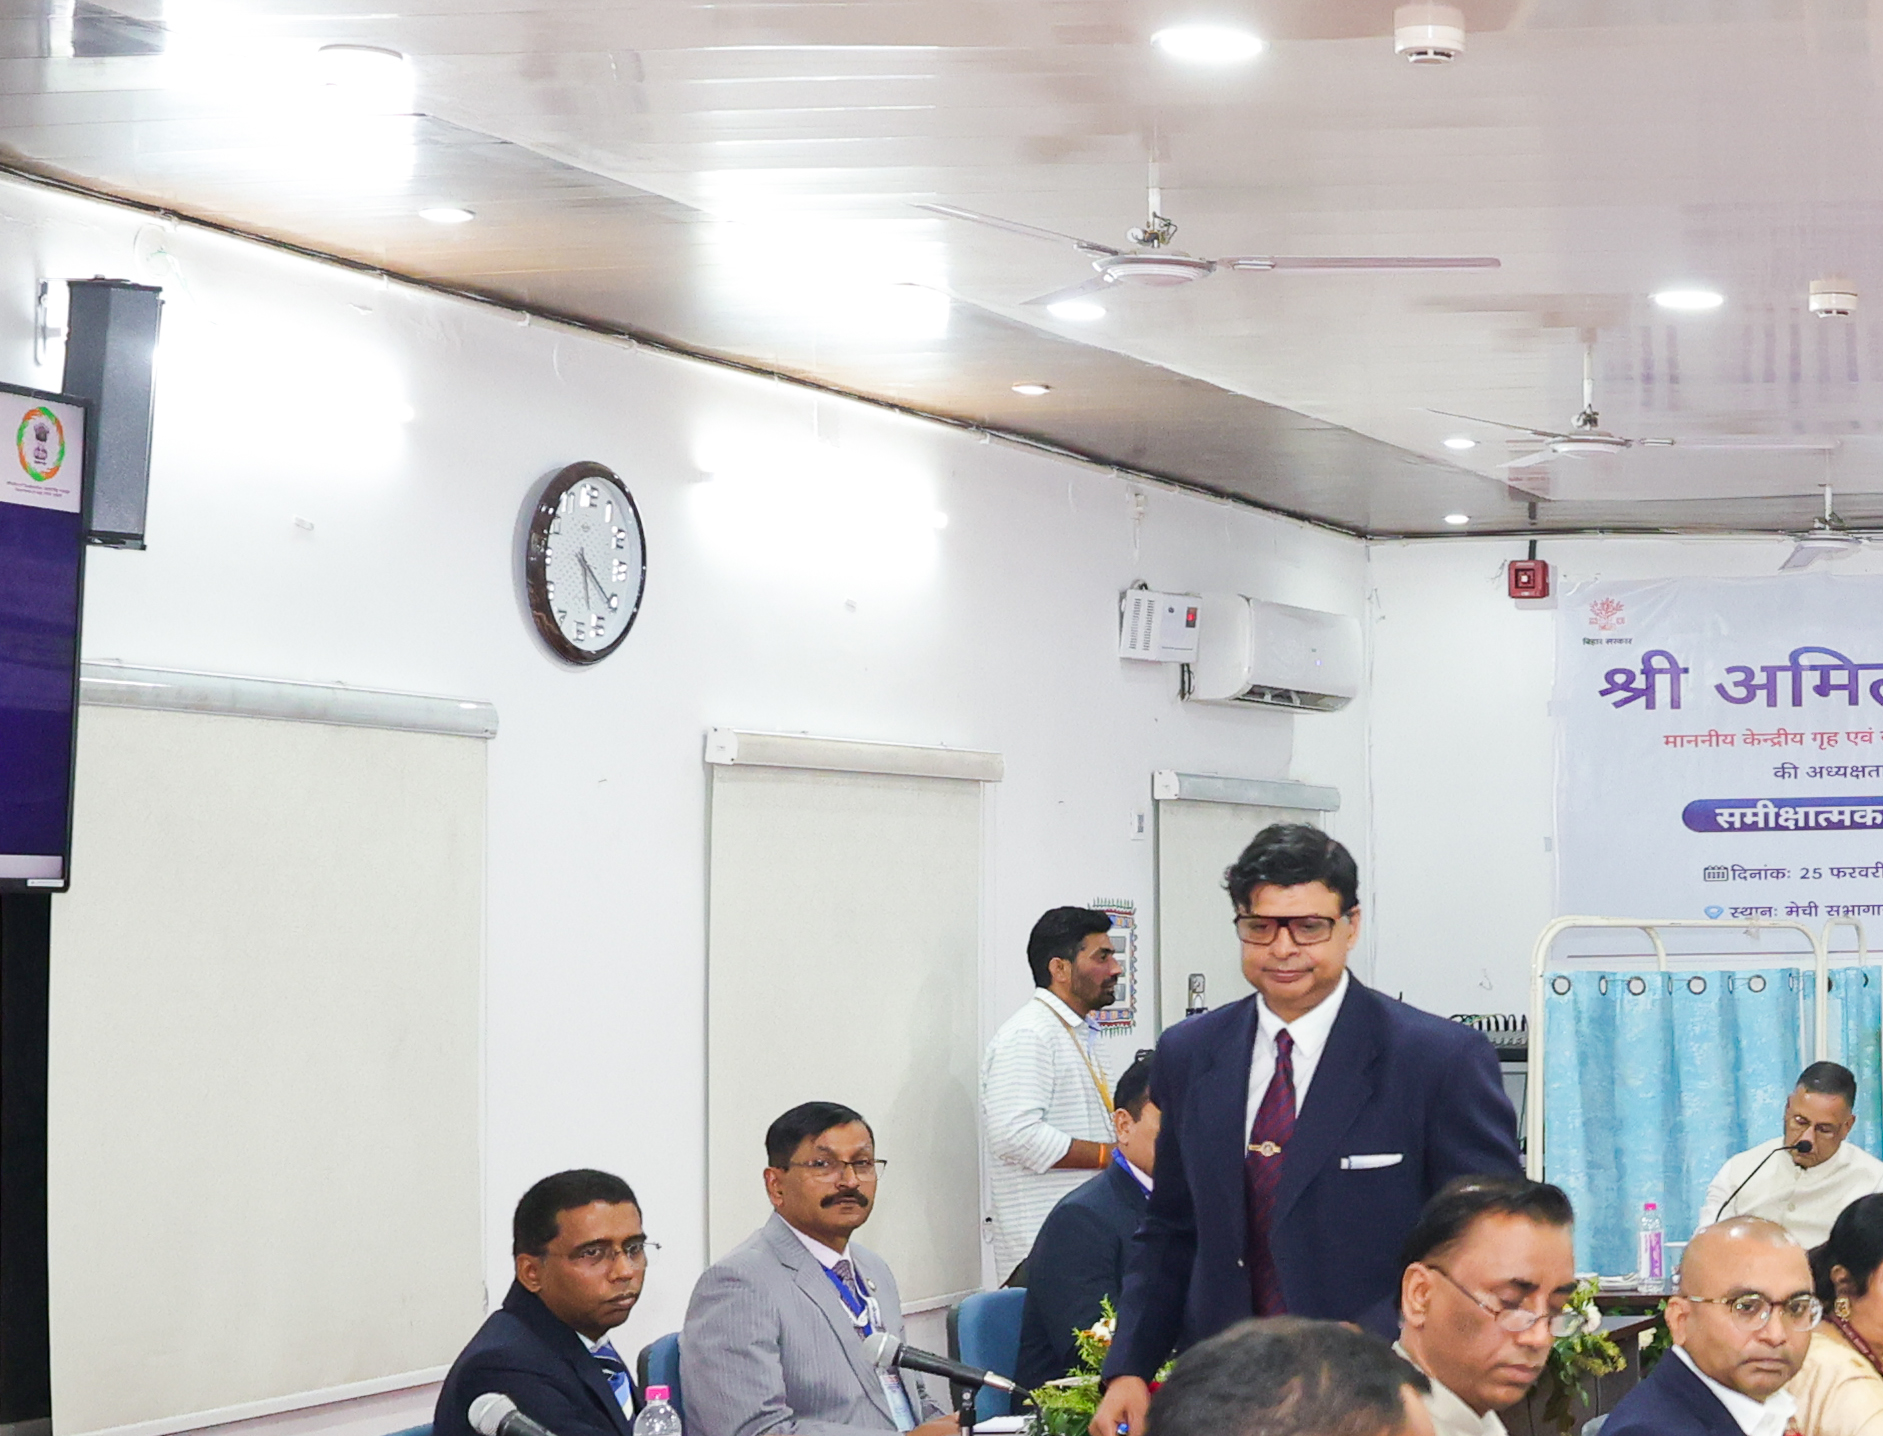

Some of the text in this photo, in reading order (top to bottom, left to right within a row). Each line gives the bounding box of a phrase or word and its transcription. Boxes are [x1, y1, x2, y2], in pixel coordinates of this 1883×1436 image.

[1598, 649, 1690, 711] श्री
[1663, 729, 1736, 747] माननीय
[1742, 728, 1805, 747] केन्द्रीय
[1811, 732, 1839, 750] गृह
[1845, 727, 1874, 746] एवं
[1773, 762, 1799, 780] की
[1800, 867, 1822, 880] 25
[1785, 901, 1818, 918] मेची
